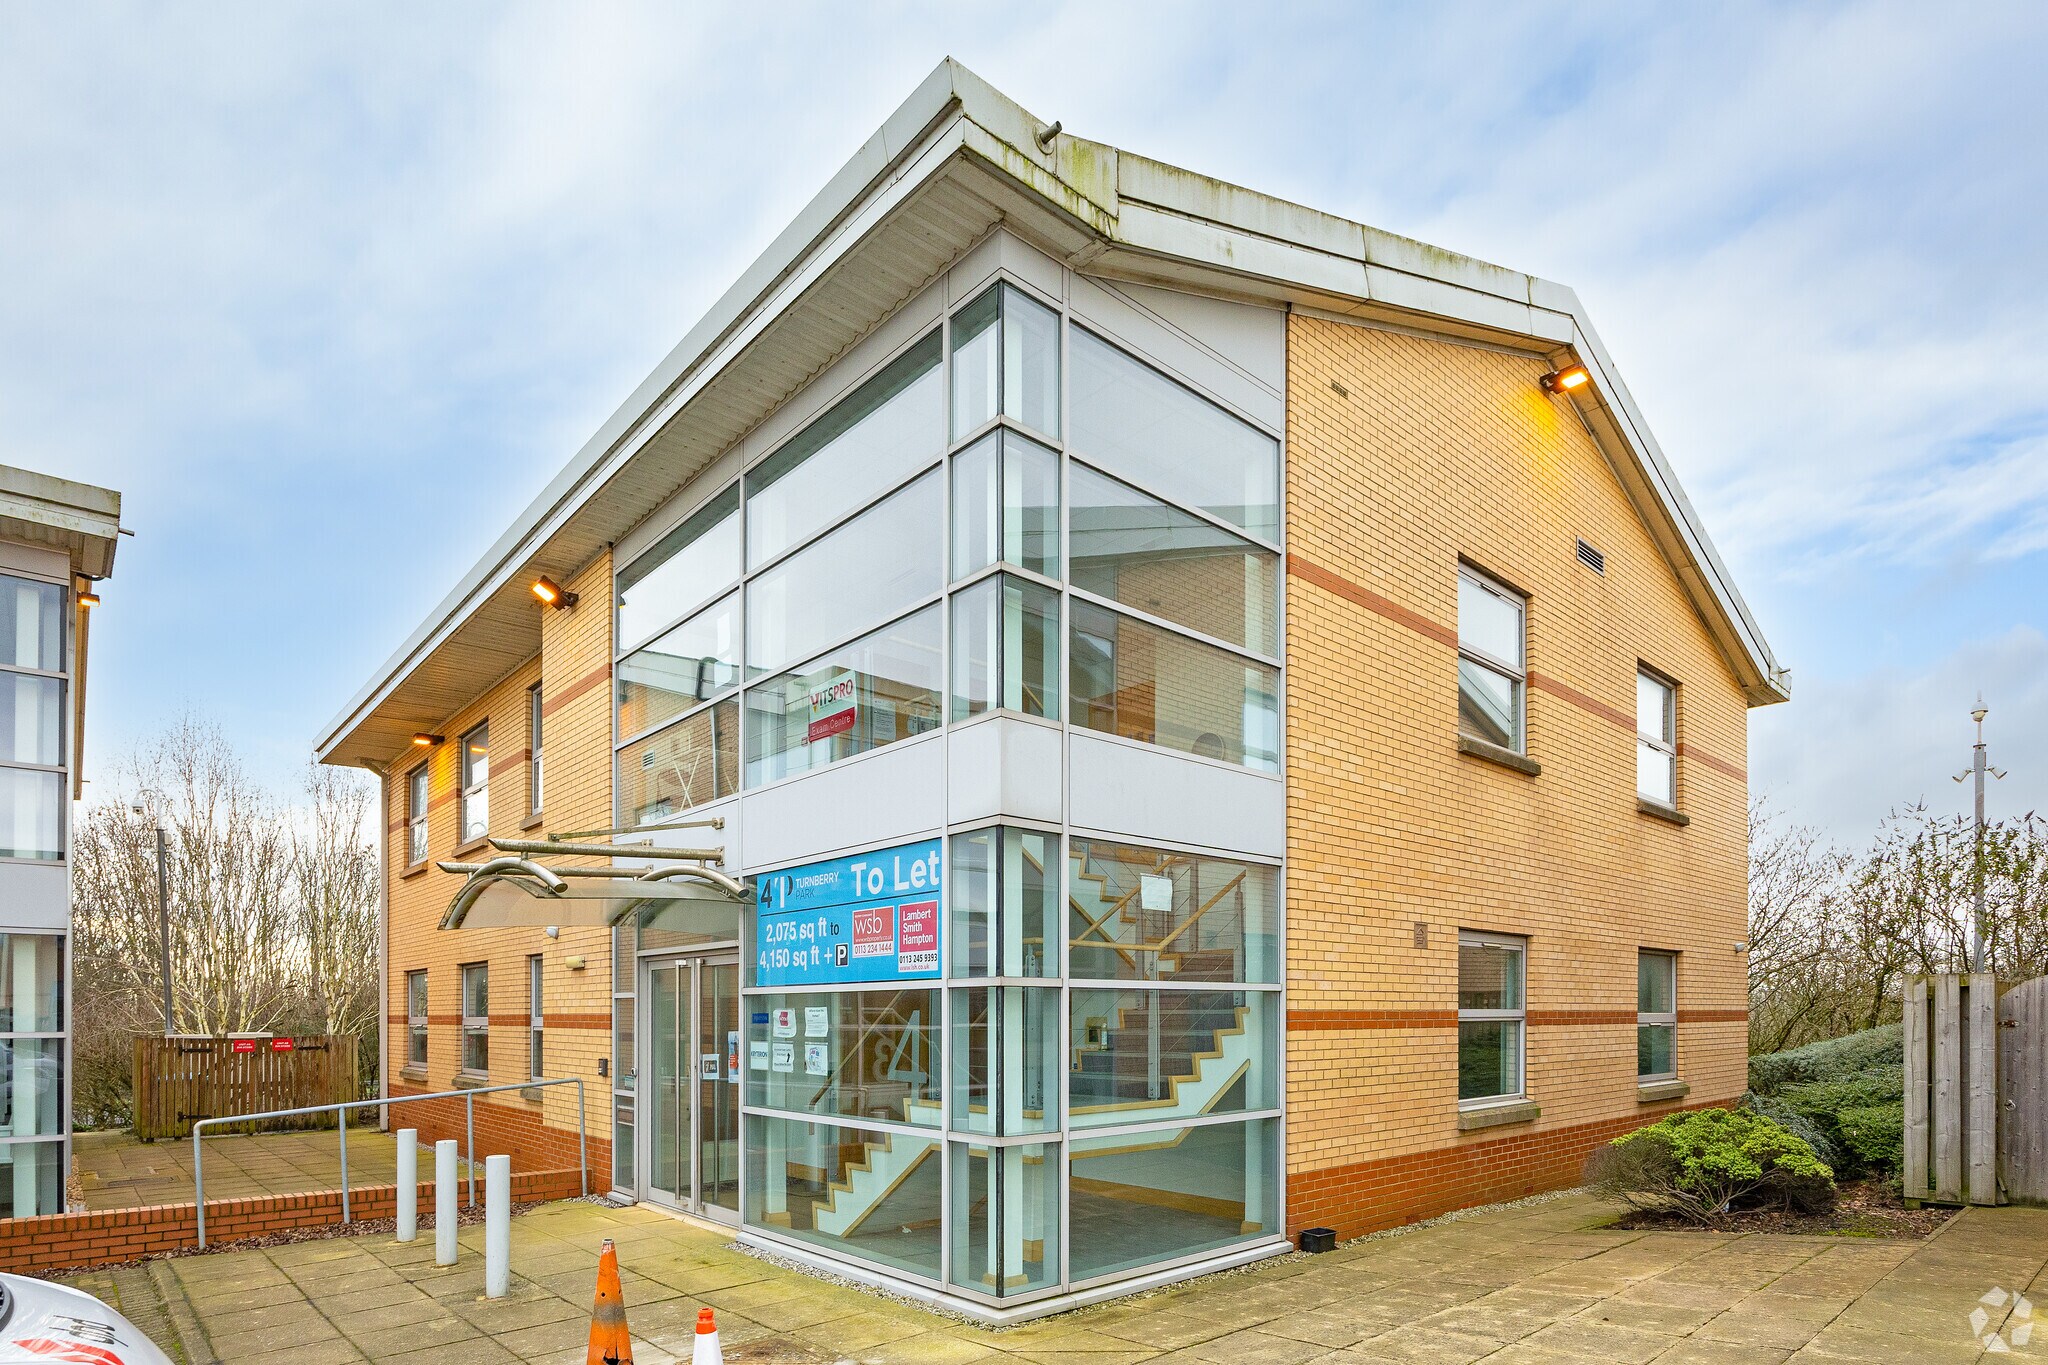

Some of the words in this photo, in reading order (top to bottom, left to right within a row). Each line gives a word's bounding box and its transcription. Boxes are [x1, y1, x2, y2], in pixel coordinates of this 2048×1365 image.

[811, 724, 829, 736] Exam
[830, 716, 851, 729] Centre
[796, 872, 839, 889] TURNBERRY
[851, 862, 884, 897] To
[894, 850, 940, 891] Let
[796, 888, 815, 900] PARK
[854, 909, 882, 934] wsb
[903, 909, 931, 921] Lambert
[766, 921, 796, 945] 2,075
[800, 922, 814, 943] sq
[818, 917, 827, 937] ft
[830, 922, 840, 936] to
[903, 922, 922, 933] Smith
[903, 934, 933, 945] Hampton
[854, 945, 867, 954] 0113
[867, 944, 878, 953] 234
[760, 948, 790, 972] 4,150
[793, 951, 807, 971] sq
[811, 945, 820, 965] ft
[837, 945, 847, 966] P
[899, 955, 912, 964] 0113
[913, 954, 923, 963] 245
[924, 953, 938, 962] 9393
[888, 1010, 928, 1105] 4
